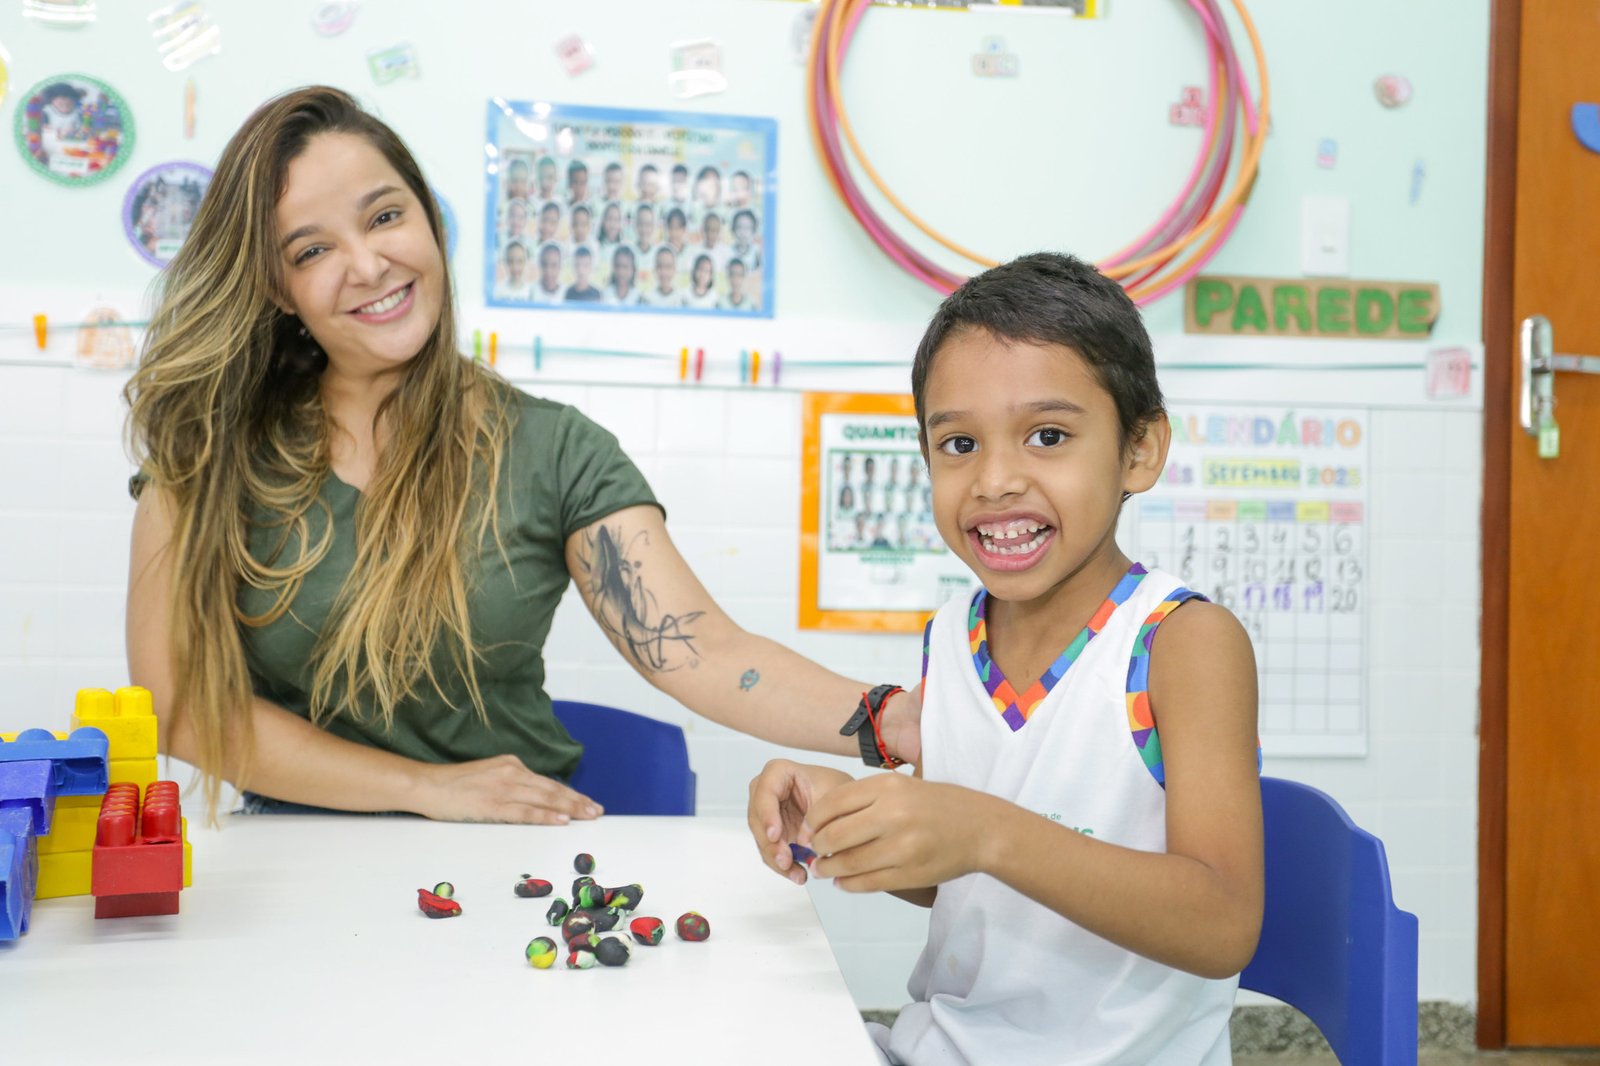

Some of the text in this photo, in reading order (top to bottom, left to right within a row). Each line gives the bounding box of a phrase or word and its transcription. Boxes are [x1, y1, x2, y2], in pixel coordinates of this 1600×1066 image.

[1194, 279, 1433, 333] PAREDE
[1170, 409, 1362, 448] ALENDÁRIO
[1216, 526, 1231, 551] 2
[1243, 523, 1260, 554] 3
[1272, 526, 1287, 552] 4
[1303, 524, 1321, 553] 5
[1334, 523, 1353, 555] 6
[1338, 557, 1362, 585] 13
[1331, 586, 1358, 613] 20
